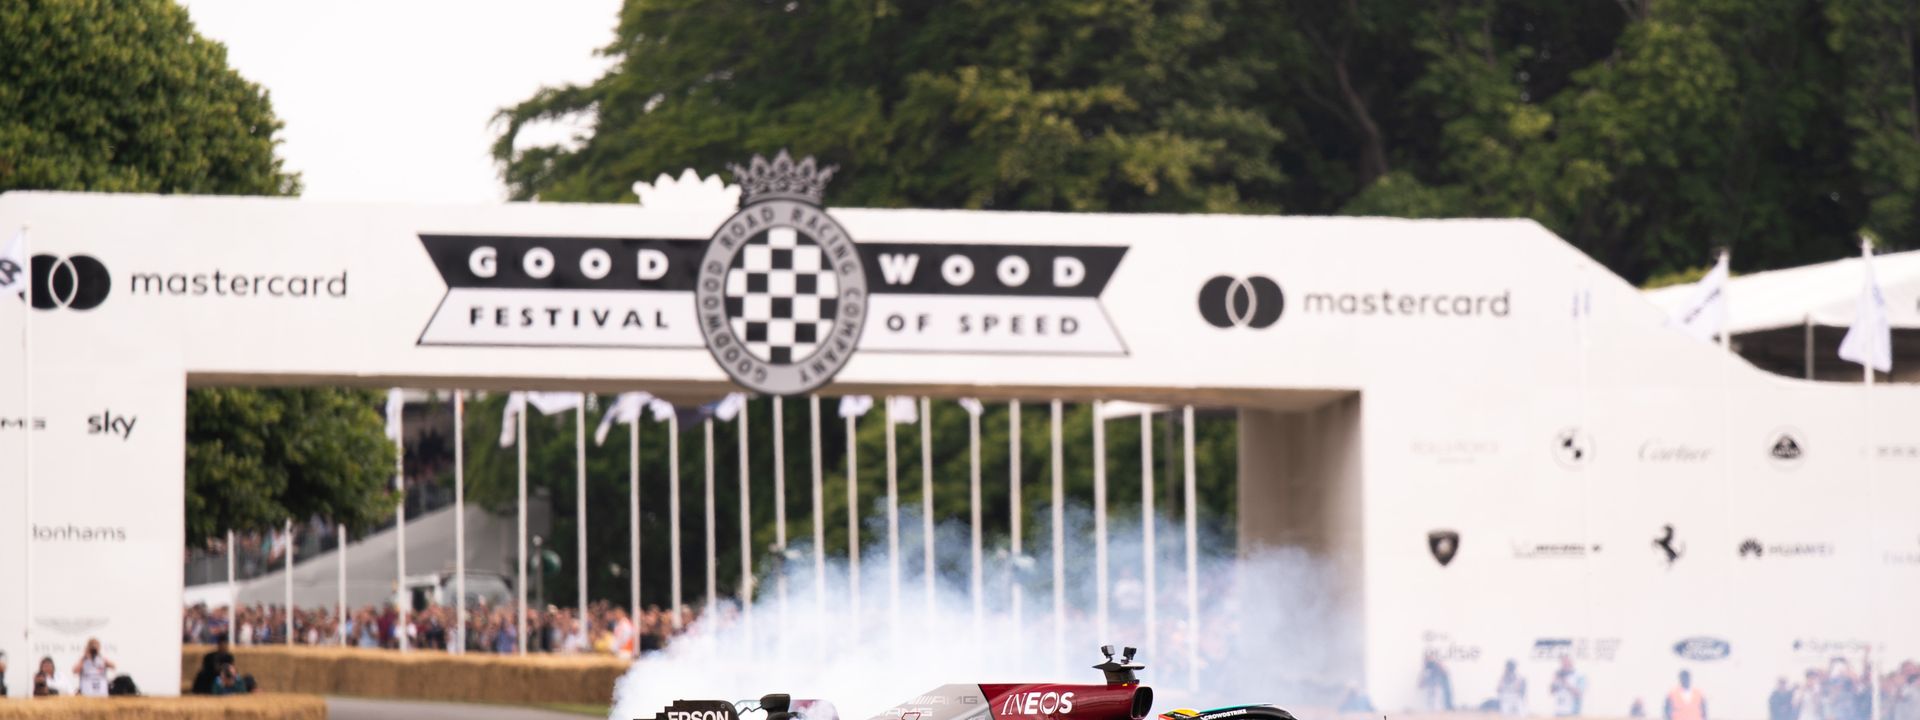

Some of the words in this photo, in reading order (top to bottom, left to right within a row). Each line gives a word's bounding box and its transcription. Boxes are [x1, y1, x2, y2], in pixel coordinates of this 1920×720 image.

[719, 206, 775, 251] ROAD
[790, 208, 859, 275] RACING
[468, 245, 670, 281] GOOD
[877, 253, 1086, 288] WOOD
[130, 269, 348, 298] mastercard
[1303, 290, 1512, 317] mastercard
[468, 307, 670, 329] FESTIVAL
[886, 314, 929, 333] OF
[958, 315, 1080, 335] SPEED
[799, 287, 860, 384] COMPANY
[87, 407, 137, 441] sky
[667, 710, 730, 720] EPSON
[1000, 691, 1075, 716] INEOS
